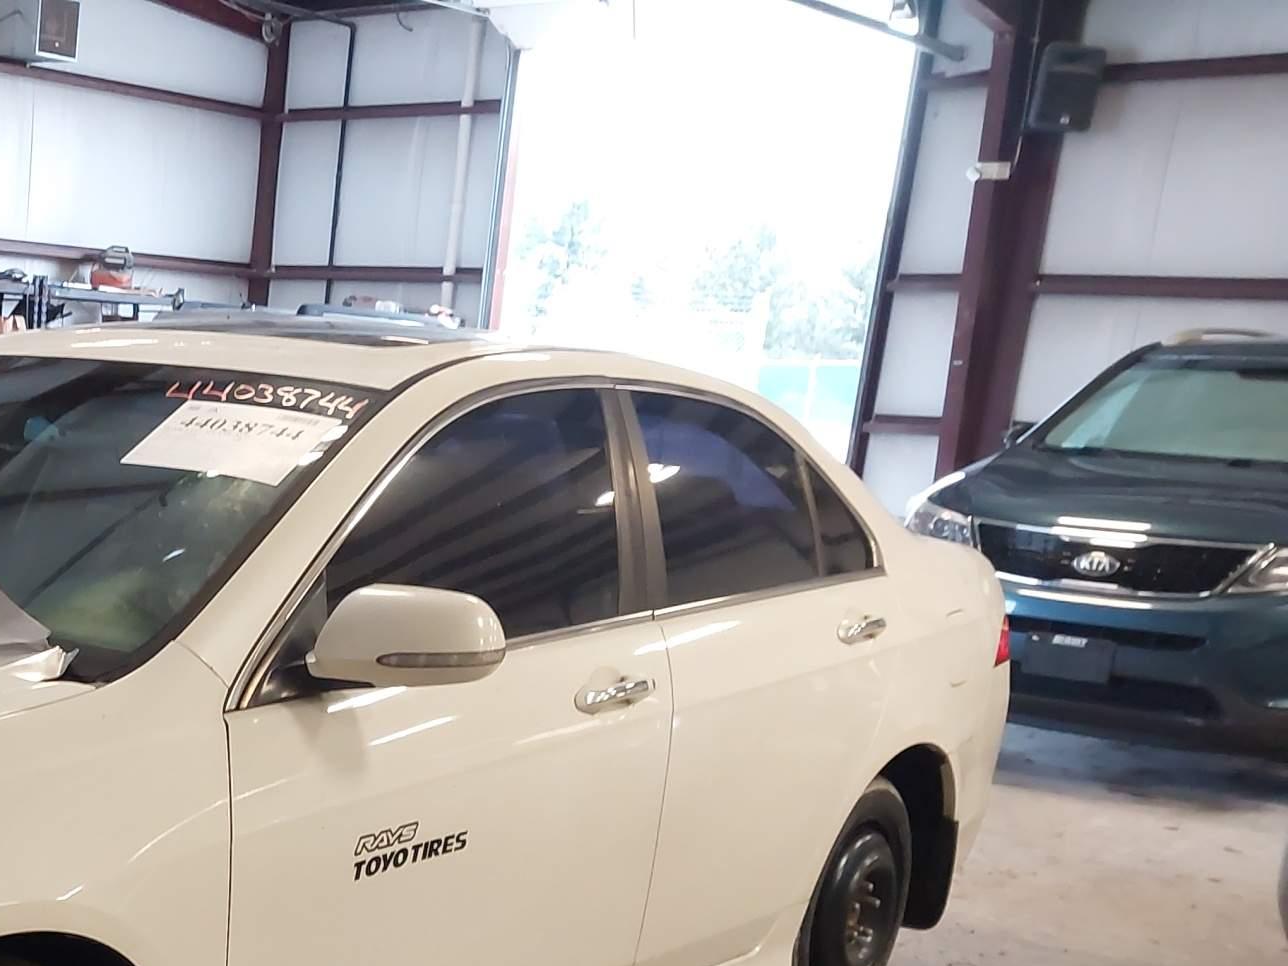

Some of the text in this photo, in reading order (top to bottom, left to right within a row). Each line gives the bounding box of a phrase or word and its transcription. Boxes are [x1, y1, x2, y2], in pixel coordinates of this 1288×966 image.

[166, 380, 368, 419] 44038744
[180, 415, 304, 441] 44038744
[354, 821, 419, 857] RAYS
